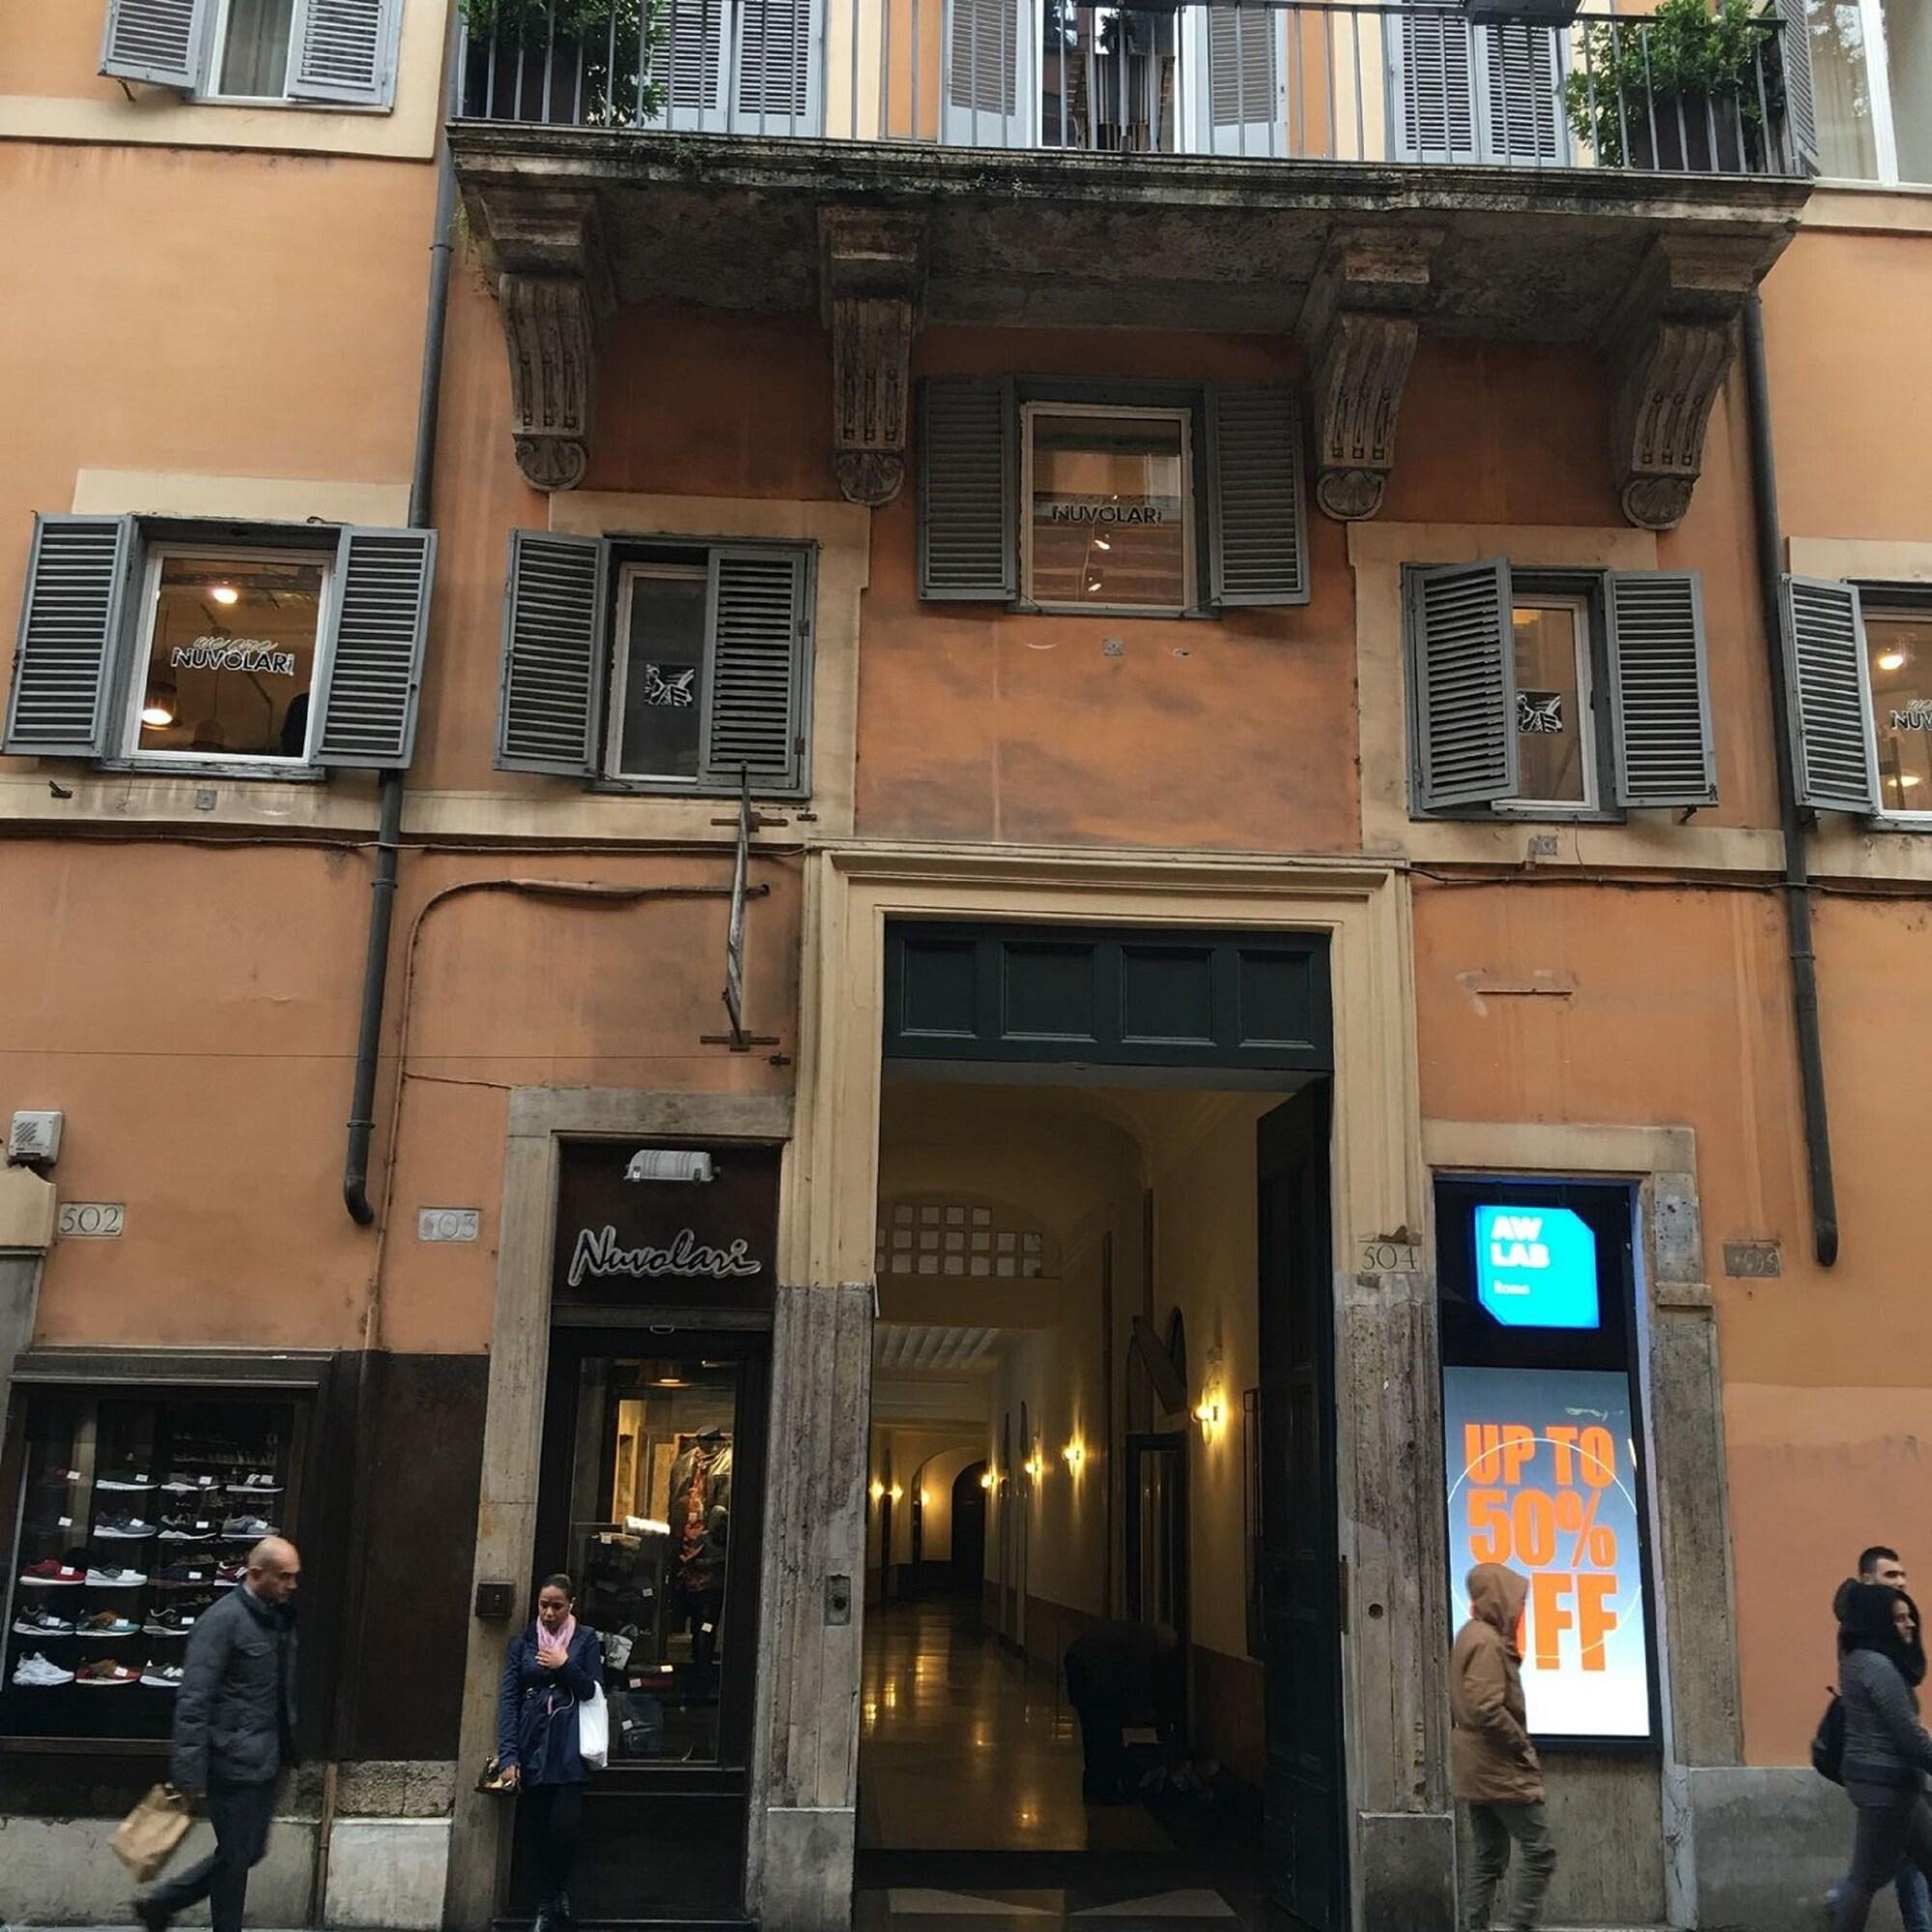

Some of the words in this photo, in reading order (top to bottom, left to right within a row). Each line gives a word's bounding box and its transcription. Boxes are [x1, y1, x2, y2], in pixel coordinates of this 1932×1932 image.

[1051, 503, 1162, 525] NUVOLARI
[171, 646, 295, 676] NUVOLARI
[60, 1206, 121, 1234] 502
[1491, 1214, 1544, 1241] AW
[1361, 1244, 1418, 1270] 504
[1490, 1240, 1550, 1269] LAB
[1463, 1423, 1536, 1486] UP
[1545, 1425, 1616, 1489] TO
[1466, 1488, 1617, 1569] 50%
[1469, 1571, 1619, 1671] FF
